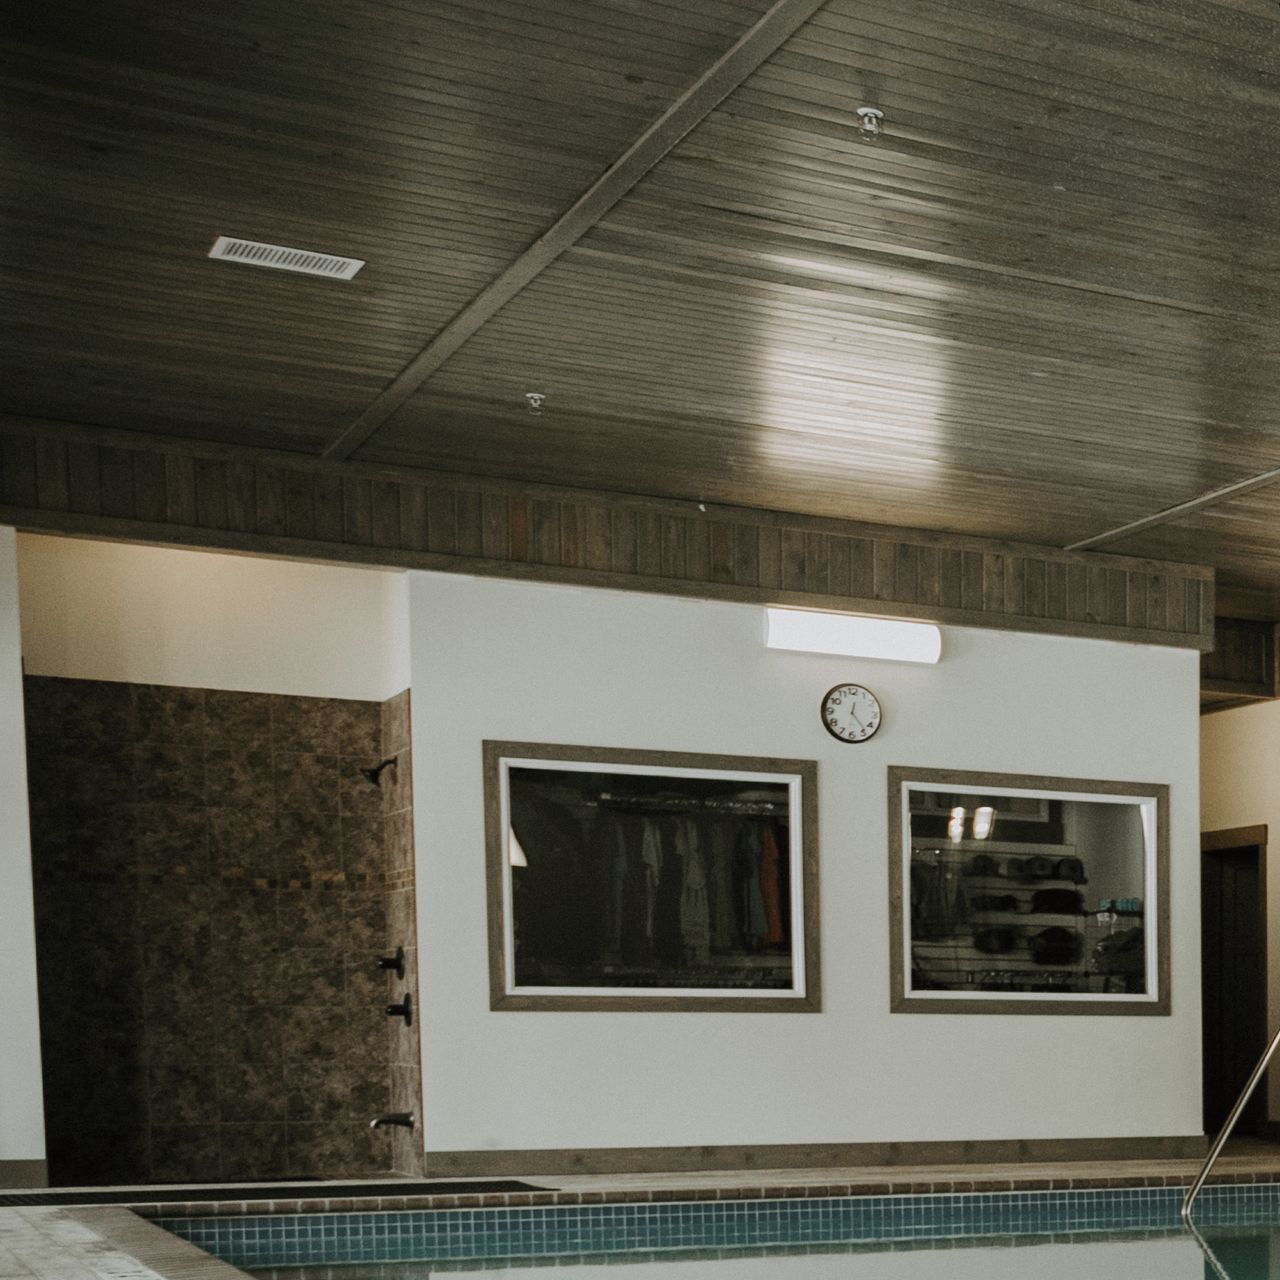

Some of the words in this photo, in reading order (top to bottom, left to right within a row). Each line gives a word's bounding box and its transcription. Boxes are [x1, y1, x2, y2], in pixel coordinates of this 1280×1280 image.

[847, 687, 858, 696] 12
[826, 706, 835, 716] 9
[830, 718, 839, 727] 8
[866, 721, 874, 729] 4
[839, 726, 846, 735] 7
[860, 728, 867, 737] 5
[848, 731, 857, 740] 6
